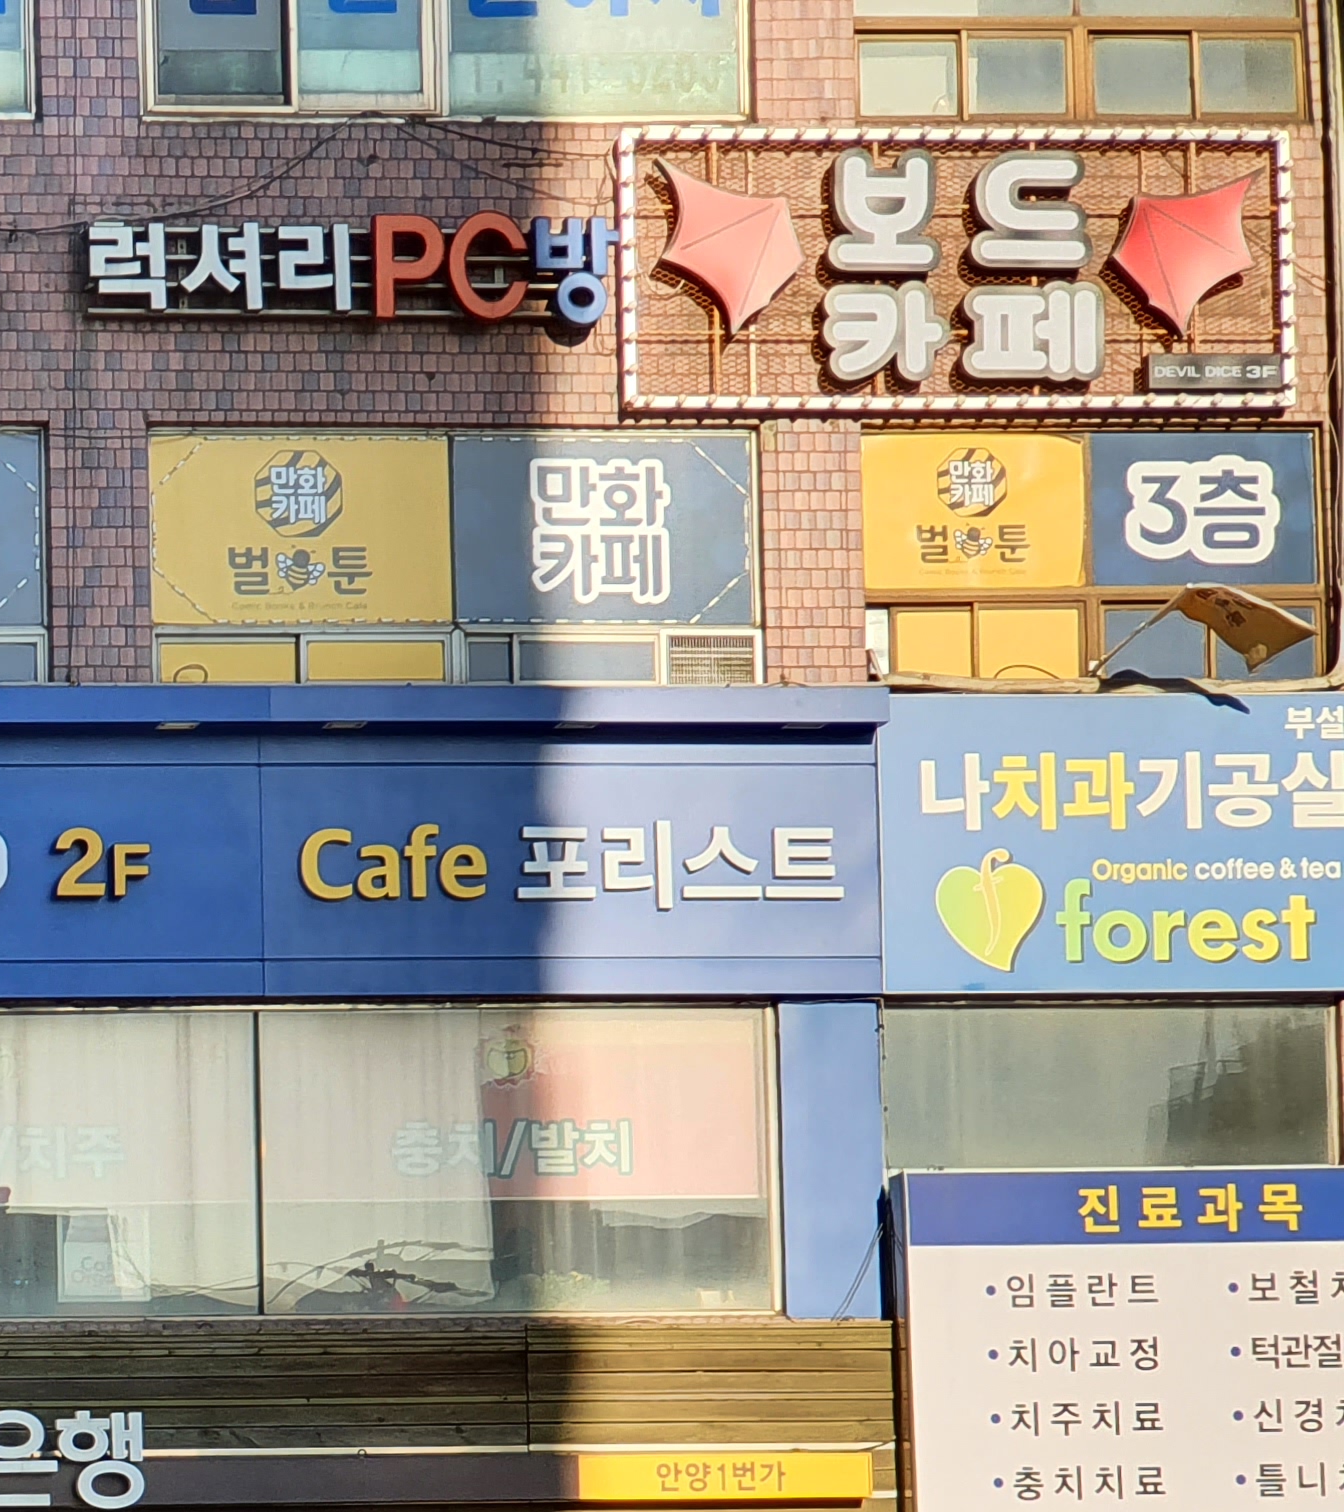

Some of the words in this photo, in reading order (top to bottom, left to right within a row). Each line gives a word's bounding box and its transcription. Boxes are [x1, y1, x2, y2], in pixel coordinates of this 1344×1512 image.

[827, 149, 1093, 272] 보드
[822, 281, 1106, 381] 카페
[1154, 365, 1202, 380] DEVIL
[1205, 365, 1242, 380] DICE
[1246, 364, 1278, 381] 3F
[269, 466, 326, 496] 만화
[949, 461, 994, 483] 만화
[270, 495, 327, 525] 카페
[530, 457, 672, 527] 만화
[949, 481, 995, 506] 카페
[1131, 461, 1275, 560] 3층
[532, 529, 671, 604] 카페
[1284, 707, 1344, 740] 부설
[919, 751, 1344, 831] 나치과기공실
[54, 827, 150, 899] 2F
[300, 823, 488, 902] Cafe
[516, 819, 846, 911] 포리스트
[1092, 858, 1188, 884] Organic
[1194, 858, 1275, 881] coffee
[1279, 859, 1298, 879] &
[1300, 858, 1341, 880] tea
[1055, 878, 1317, 963] forest
[391, 1118, 634, 1177] 충치/발치
[1077, 1183, 1305, 1233] 진료과목
[1005, 1272, 1161, 1308] 임플란트
[1008, 1336, 1162, 1373] 치아교정
[1251, 1333, 1344, 1369] 턱관절
[1010, 1401, 1166, 1436] 치주치료
[1253, 1398, 1344, 1433] 신경
[656, 1460, 786, 1493] 안양1번가
[1012, 1465, 1167, 1501] 충치치료
[1255, 1461, 1344, 1498] 틀니
